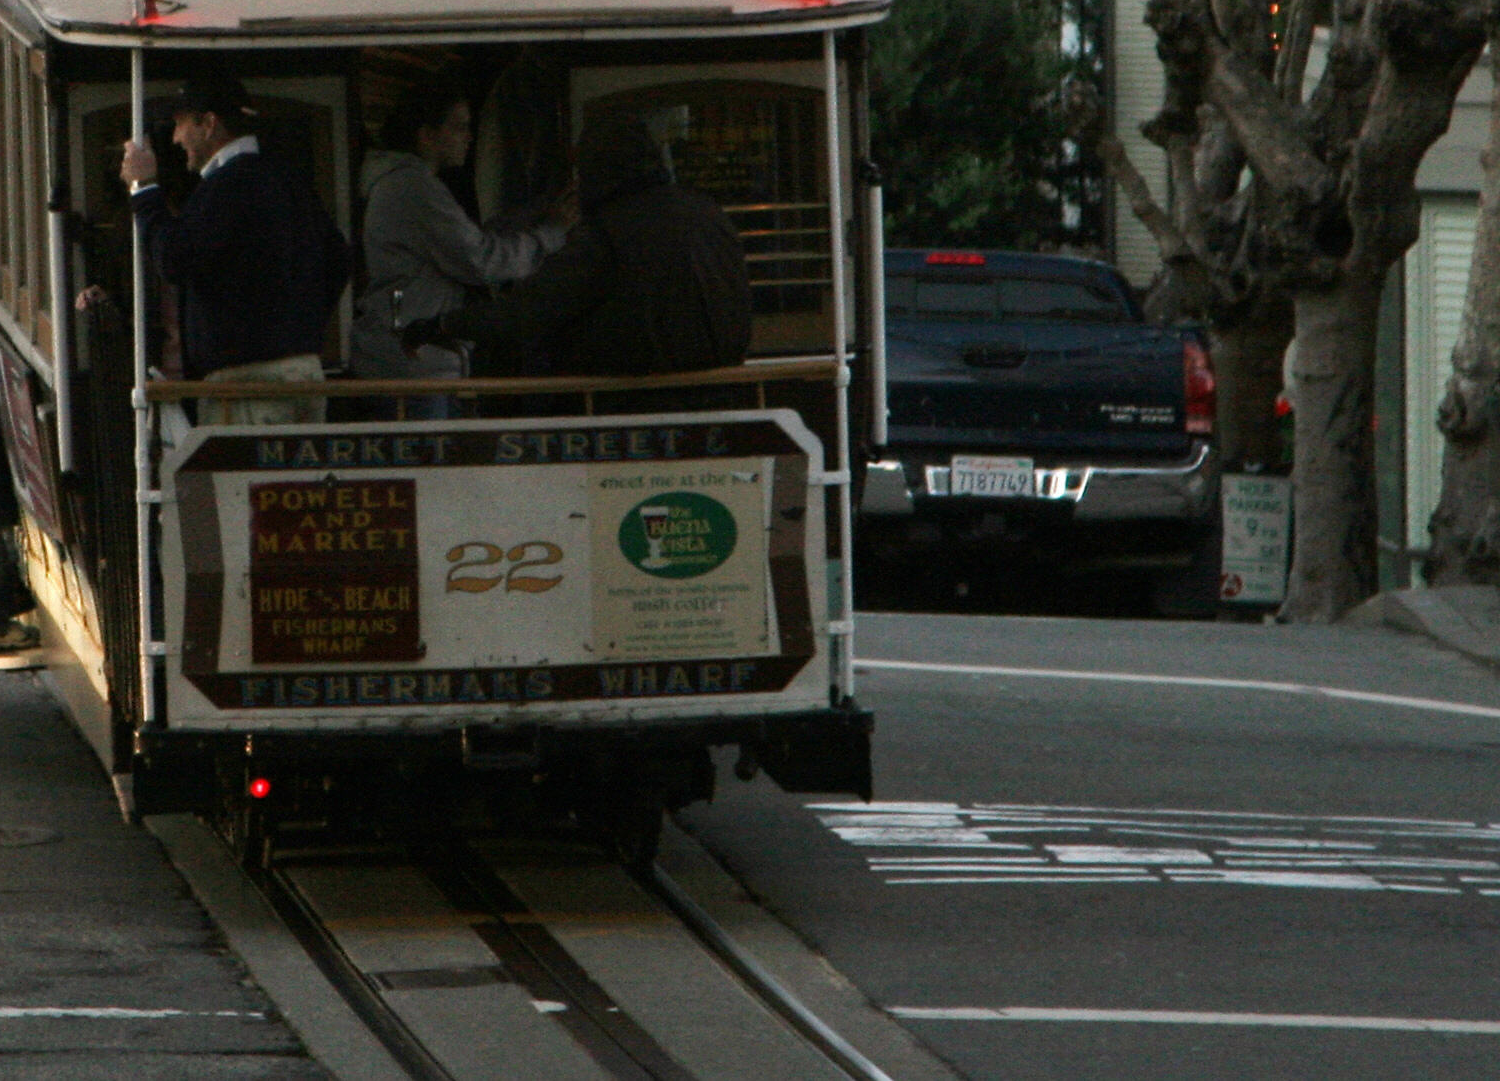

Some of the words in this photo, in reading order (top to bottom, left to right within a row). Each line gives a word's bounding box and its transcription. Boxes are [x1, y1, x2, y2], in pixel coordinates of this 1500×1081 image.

[255, 435, 453, 466] MARKET
[495, 428, 684, 462] STREET
[258, 488, 407, 511] POWELL
[300, 510, 372, 528] AND
[257, 529, 410, 552] MARKET
[445, 541, 563, 593] 22
[259, 588, 310, 611] HYDE
[344, 587, 410, 610] BEACH
[272, 618, 397, 636] FISHERMANS
[303, 637, 366, 654] WHARF
[240, 670, 555, 707] FISHERMANS
[598, 662, 757, 696] WHARF
